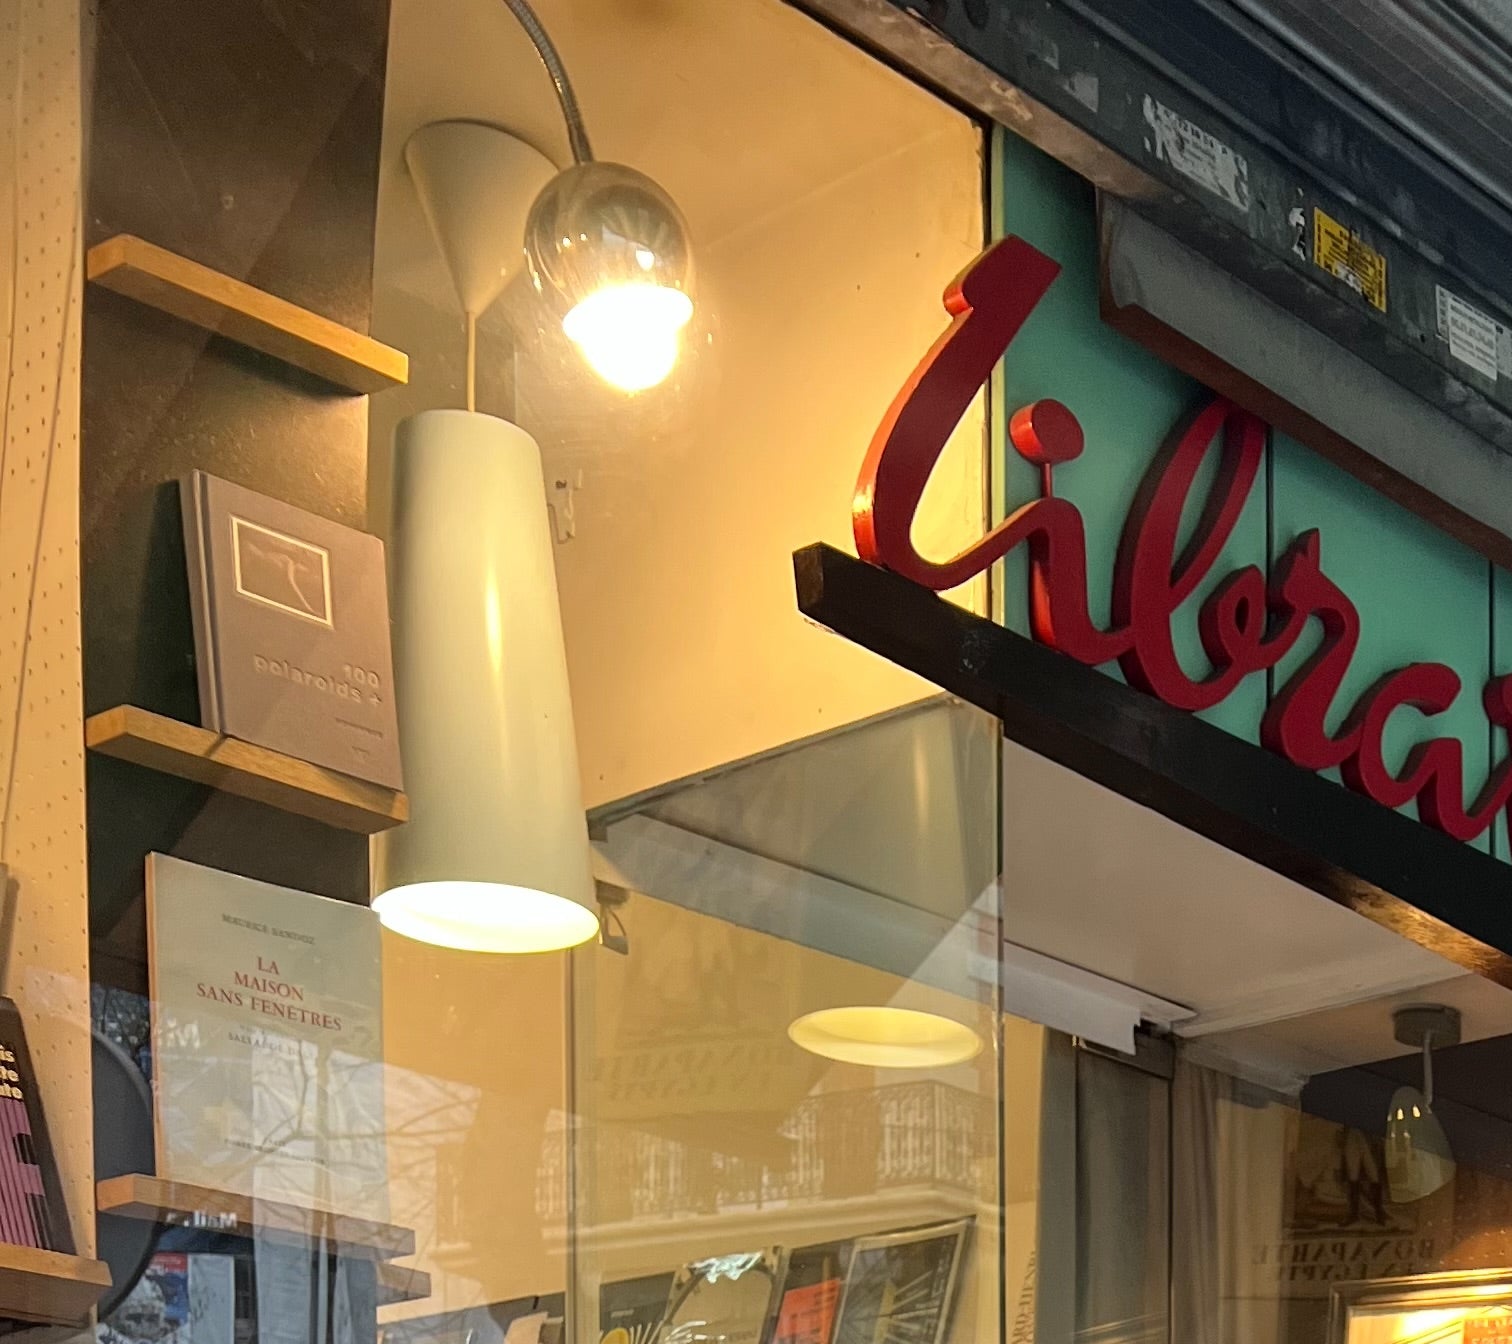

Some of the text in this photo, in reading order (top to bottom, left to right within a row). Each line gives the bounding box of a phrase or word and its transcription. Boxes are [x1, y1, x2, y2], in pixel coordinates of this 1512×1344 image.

[255, 654, 362, 703] polaroids
[344, 663, 381, 689] 100
[256, 956, 280, 975] LA
[197, 982, 243, 1007] SANS
[234, 971, 304, 1001] MAISON
